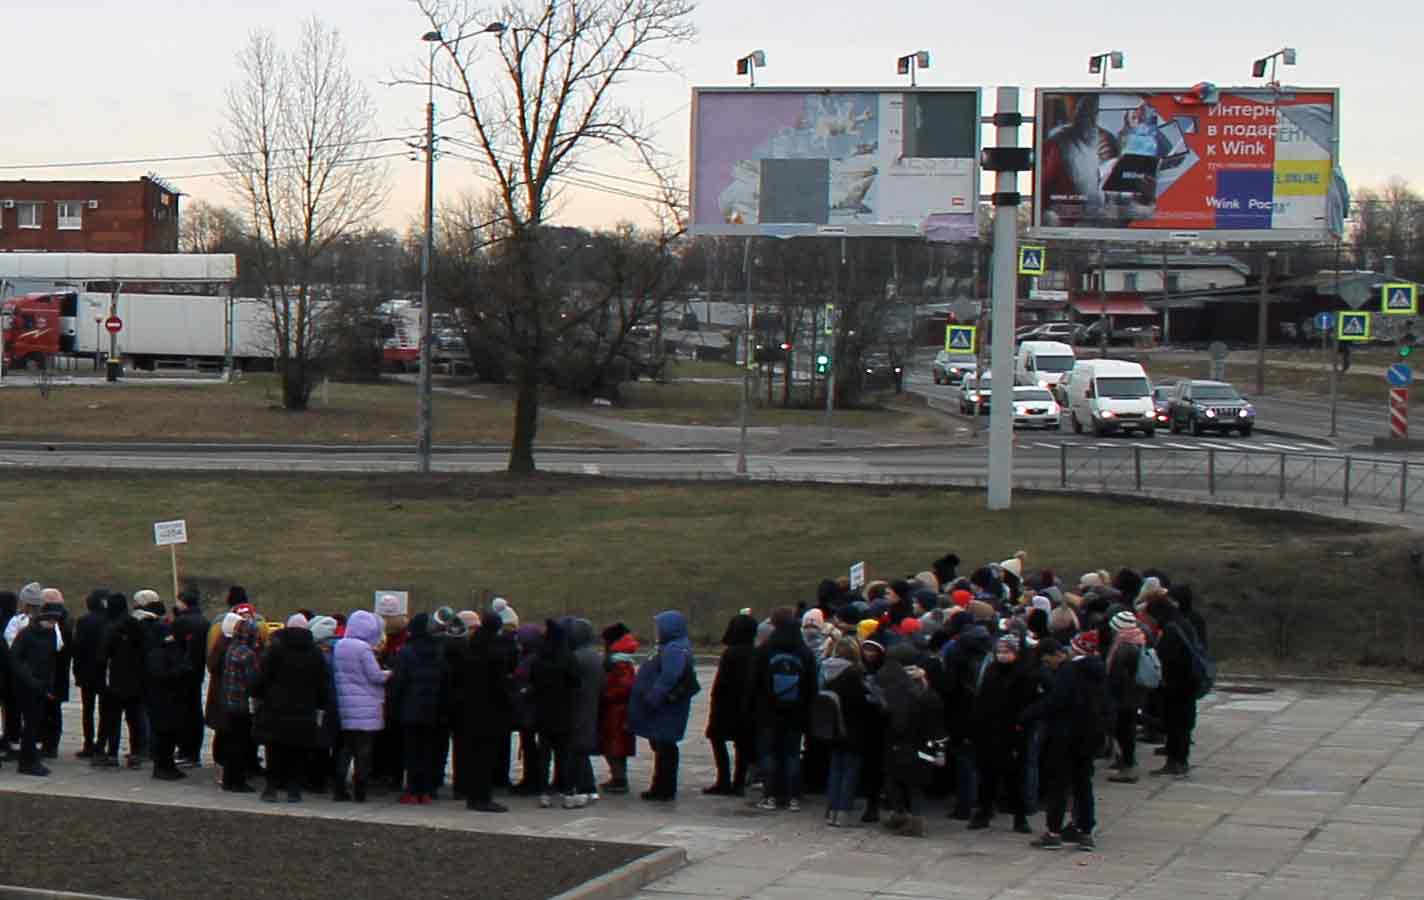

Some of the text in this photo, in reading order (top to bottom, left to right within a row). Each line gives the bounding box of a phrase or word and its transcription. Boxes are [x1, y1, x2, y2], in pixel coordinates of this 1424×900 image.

[1207, 125, 1216, 136] в
[1207, 141, 1265, 155] к Wink
